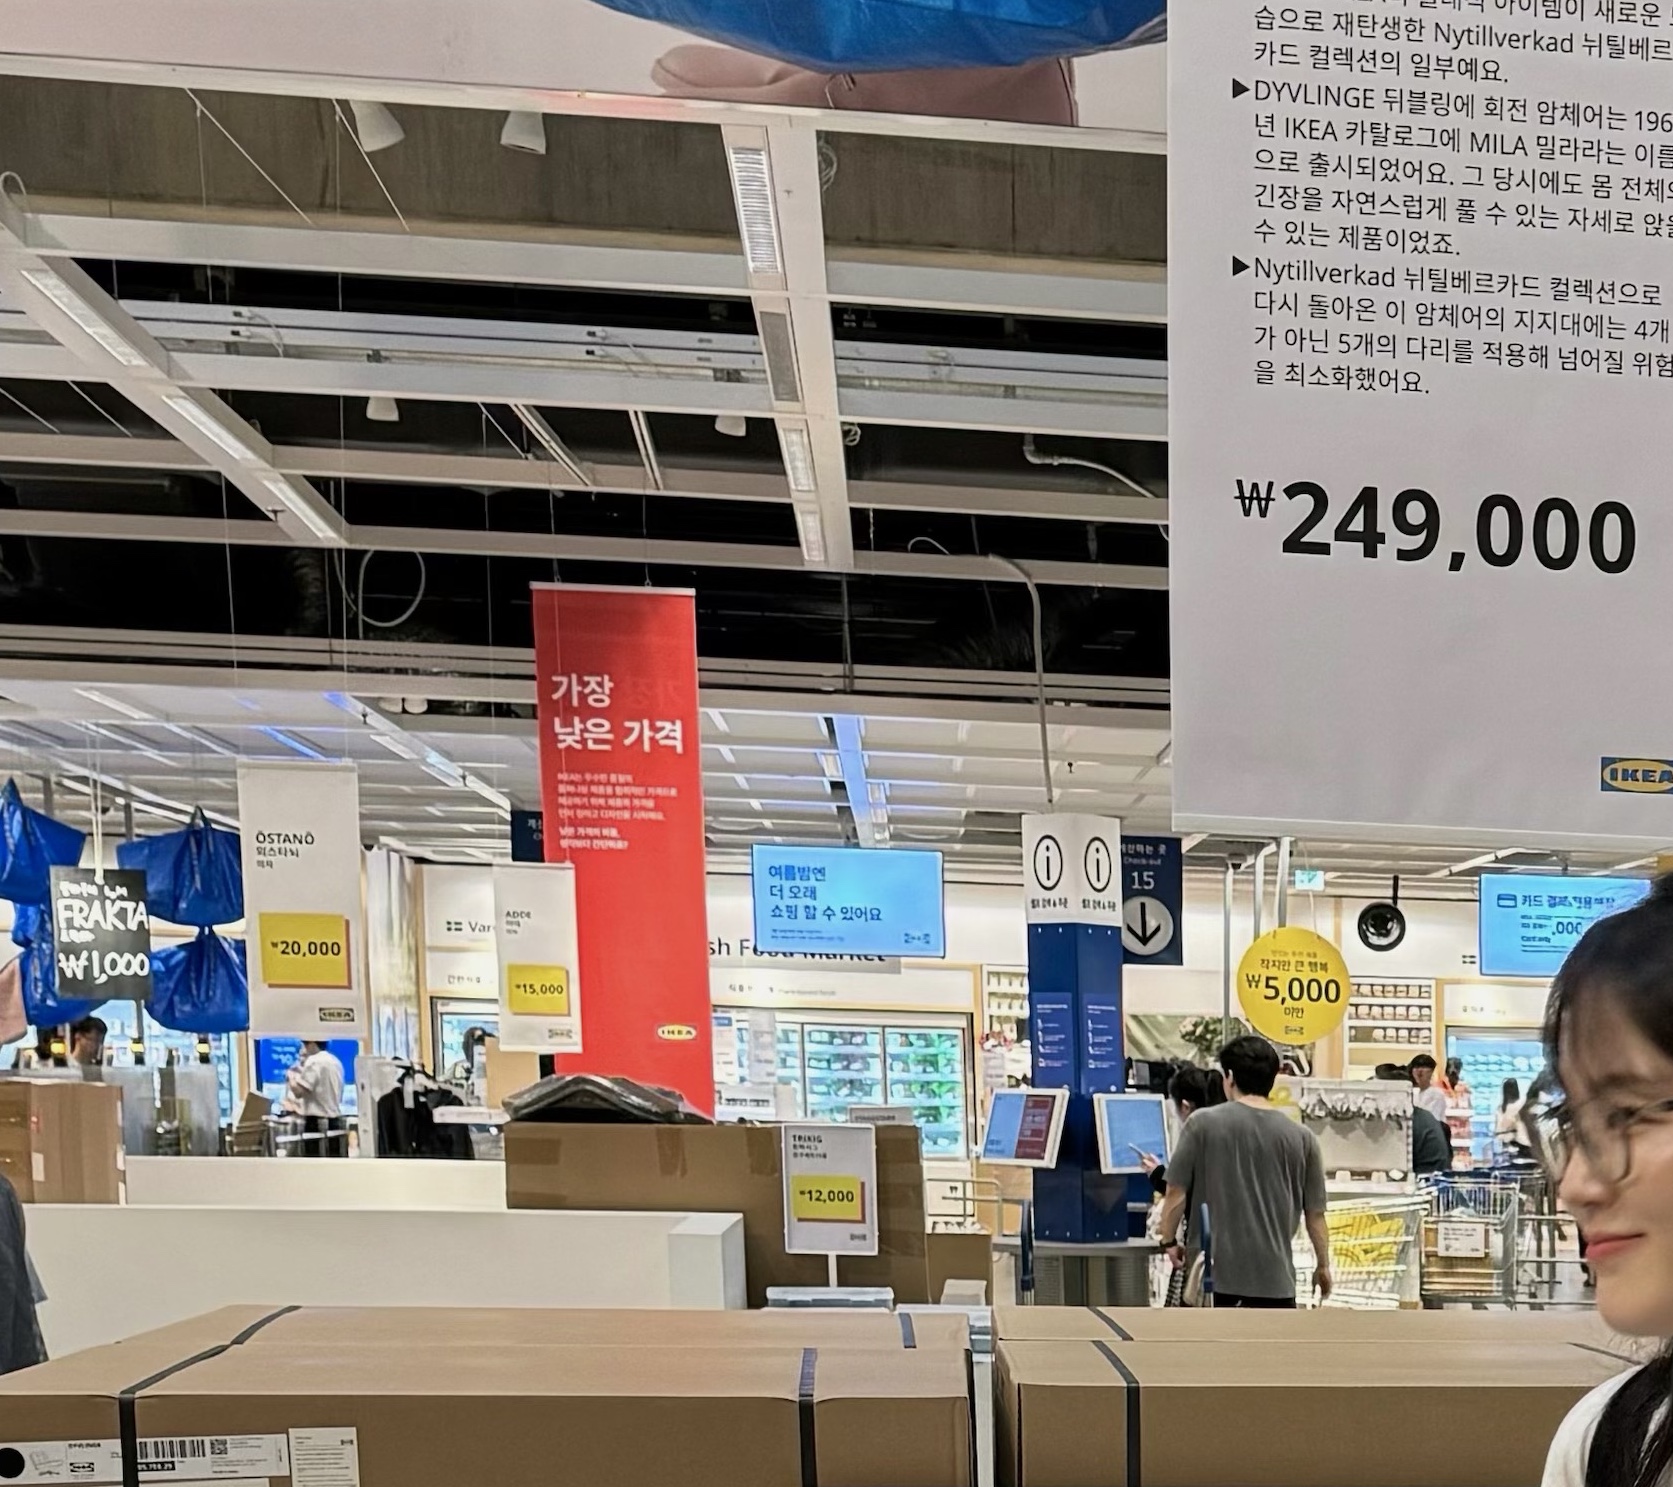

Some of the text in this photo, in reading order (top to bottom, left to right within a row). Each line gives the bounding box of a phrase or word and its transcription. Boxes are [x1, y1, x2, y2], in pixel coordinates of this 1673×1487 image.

[1594, 0, 1662, 27] 새로운
[1254, 5, 1673, 62] 습으로 재탄생한 Nytillverkad 뉘틸베르
[1254, 40, 1508, 83] 카드 컬렉션의 일부예요.
[1254, 79, 1375, 109] DYVLINGE
[1382, 88, 1474, 119] 뒤블링에
[1483, 95, 1528, 123] 회전
[1537, 100, 1628, 131] 암체어는
[1255, 112, 1275, 139] 년
[1284, 117, 1338, 142] IKEA
[1345, 119, 1460, 153] 카탈로그에
[1469, 132, 1529, 157] MILA
[1536, 135, 1627, 166] 밀라라는
[1254, 148, 1300, 173] 으로
[1308, 152, 1454, 186] 출시되었어요.
[1461, 165, 1485, 186] 그
[1493, 166, 1583, 196] 당시에도
[1591, 174, 1613, 199] 몸
[1254, 183, 1323, 212] 긴장을
[1331, 189, 1447, 222] 자연스럽게
[1455, 198, 1477, 224] 풀
[1485, 201, 1507, 226] 수
[1515, 203, 1560, 230] 있는
[1567, 207, 1635, 234] 자세로
[1254, 218, 1460, 256] 수 있는 제품이었죠.
[1254, 256, 1663, 306] Nytillverkad 뉘틸베르카드 컬렉션으로
[1254, 290, 1670, 344] 다시 돌아온 이 암체어의 지지대에는 4개
[1254, 325, 1277, 351] 가
[1284, 327, 1329, 354] 아닌
[1337, 332, 1396, 359] 5개의
[1406, 336, 1474, 364] 다리를
[1482, 341, 1548, 370] 적용해
[1557, 346, 1624, 375] 넘어질
[1254, 359, 1430, 395] 을 최소화했어요.
[1234, 478, 1637, 575] ₩249,000
[551, 672, 615, 708] 가장
[553, 715, 684, 754] 낮은 가격
[256, 832, 315, 846] ÖSTANÖ
[768, 864, 826, 882] 여름밤엔
[1131, 870, 1155, 890] 15
[769, 885, 818, 901] 더 오래
[57, 898, 149, 931] FRAKTA
[770, 904, 799, 920] 쇼핑
[822, 905, 837, 922] 수
[840, 905, 883, 922] 있어요
[58, 949, 151, 985] ₩1,000
[1245, 972, 1341, 1006] ₩5,000
